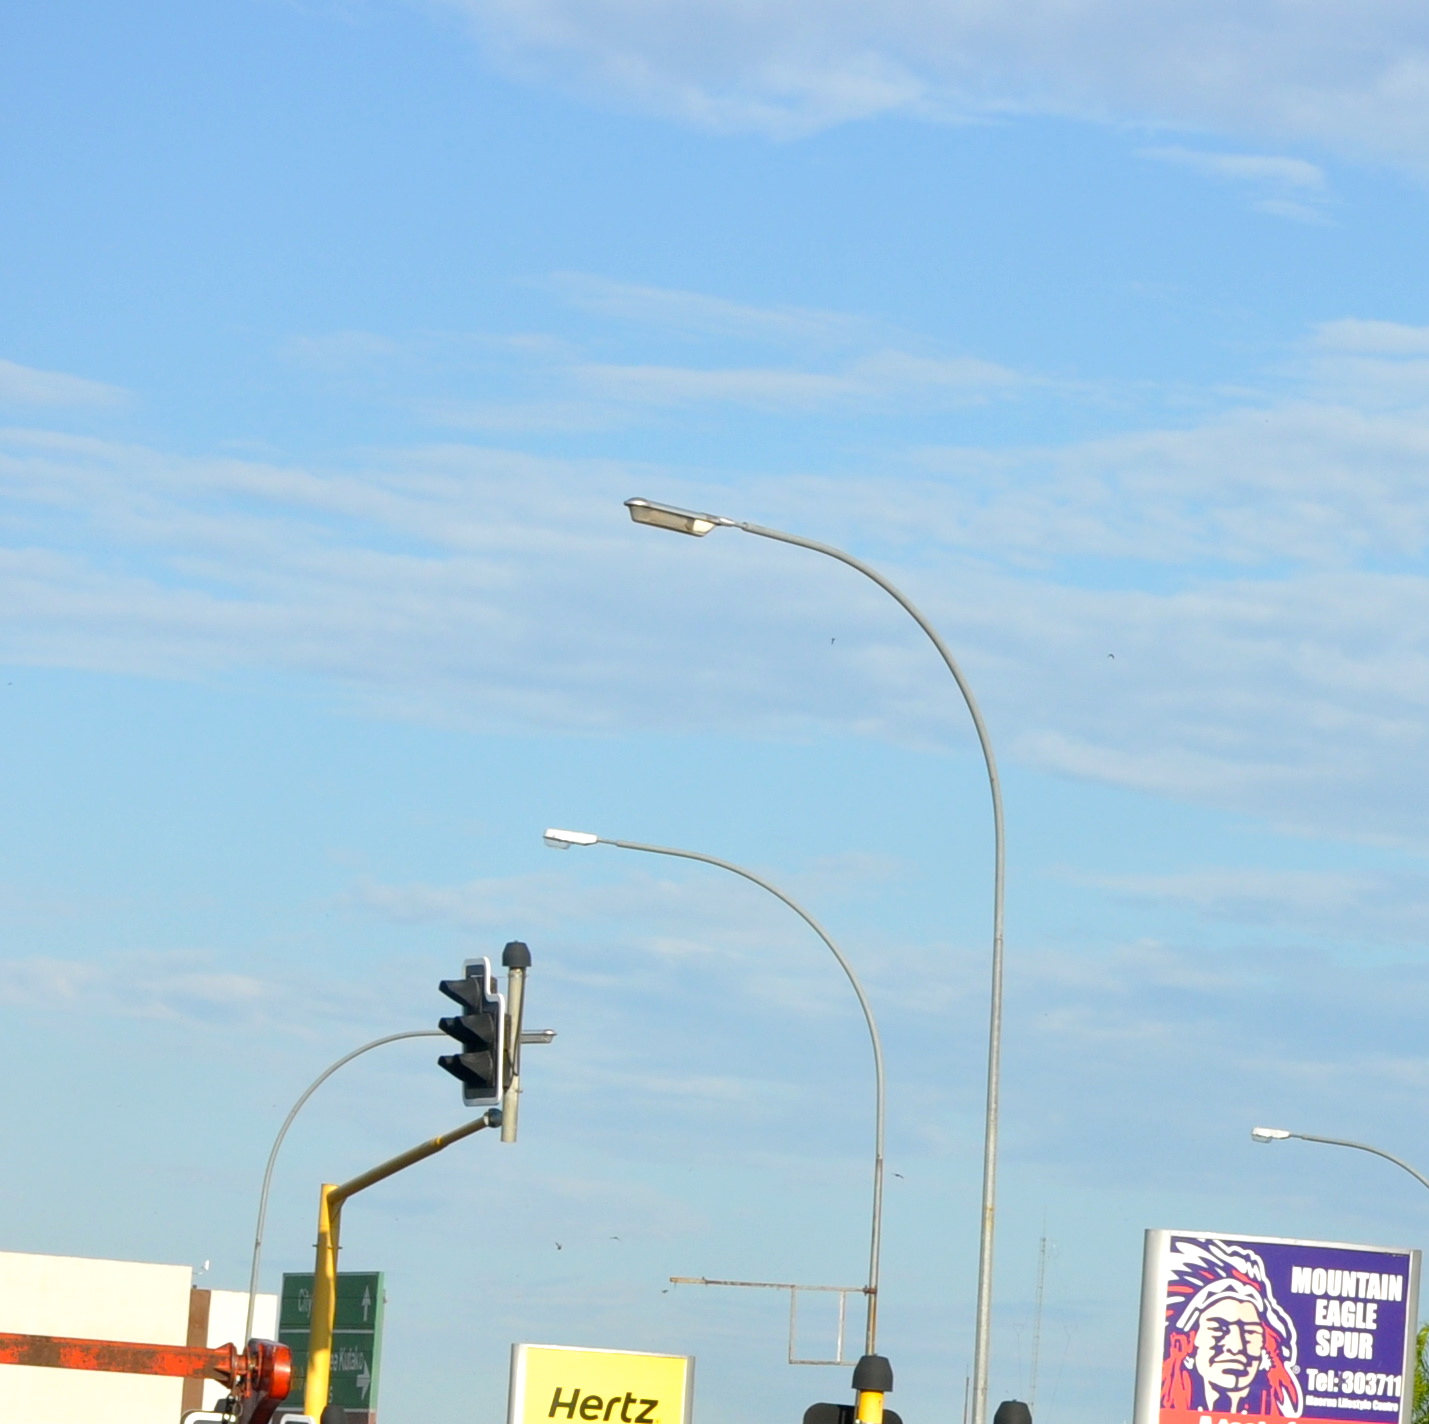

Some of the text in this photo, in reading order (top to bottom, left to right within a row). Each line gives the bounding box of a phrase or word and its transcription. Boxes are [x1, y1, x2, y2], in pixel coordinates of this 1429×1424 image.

[1291, 1265, 1403, 1302] MOUNTAIN
[1314, 1298, 1378, 1330] EAGLE
[1315, 1329, 1373, 1360] SPUR
[1306, 1368, 1402, 1397] Tel: 303711
[548, 1387, 659, 1424] Hertz
